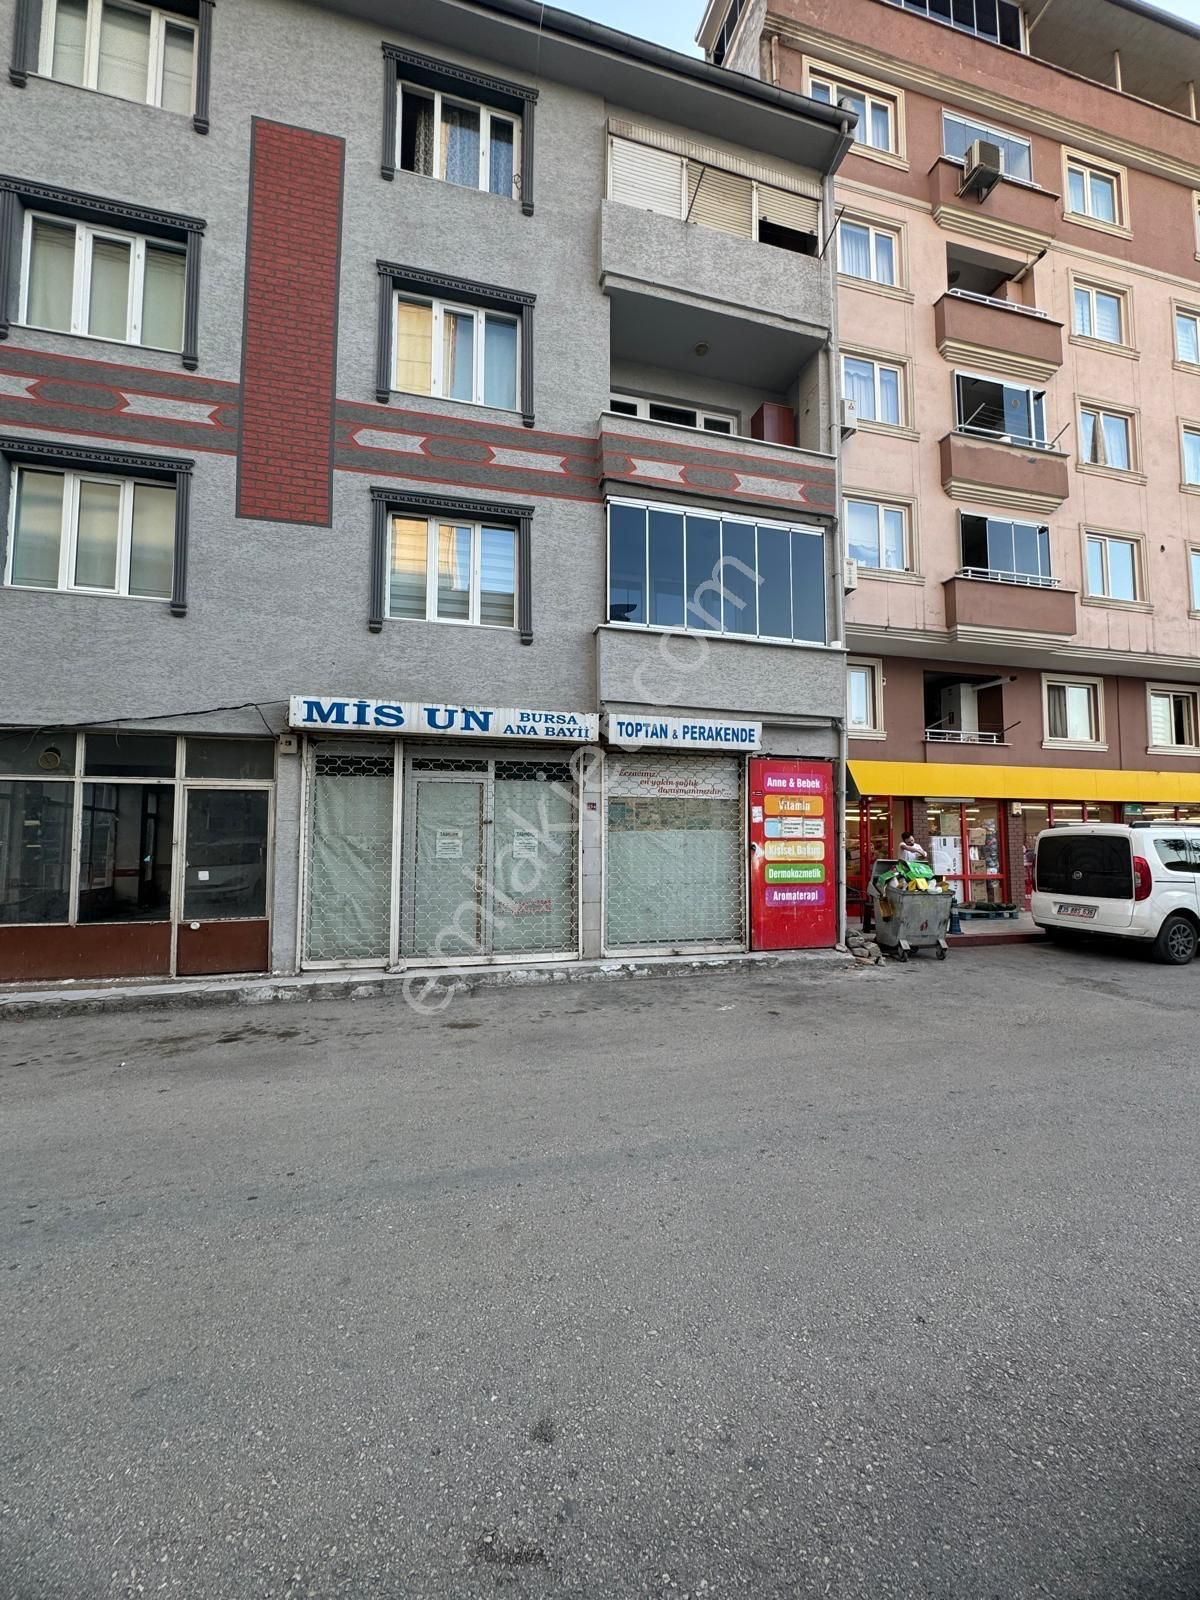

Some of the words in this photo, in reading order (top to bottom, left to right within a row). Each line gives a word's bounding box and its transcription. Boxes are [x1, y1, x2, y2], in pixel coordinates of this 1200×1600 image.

[302, 700, 405, 727] MİS
[423, 707, 493, 731] UN
[519, 712, 579, 725] BURSA
[503, 724, 538, 736] ANA
[616, 721, 668, 739] TOPTAN
[672, 729, 679, 739] &
[682, 725, 755, 743] PERAKENDE
[767, 777, 787, 788] Anne
[789, 778, 795, 787] &
[797, 778, 820, 788] Bebek
[778, 800, 811, 811] Vitamin
[768, 869, 822, 879] Dermokozmetik
[773, 891, 818, 902] Aromaterapi
